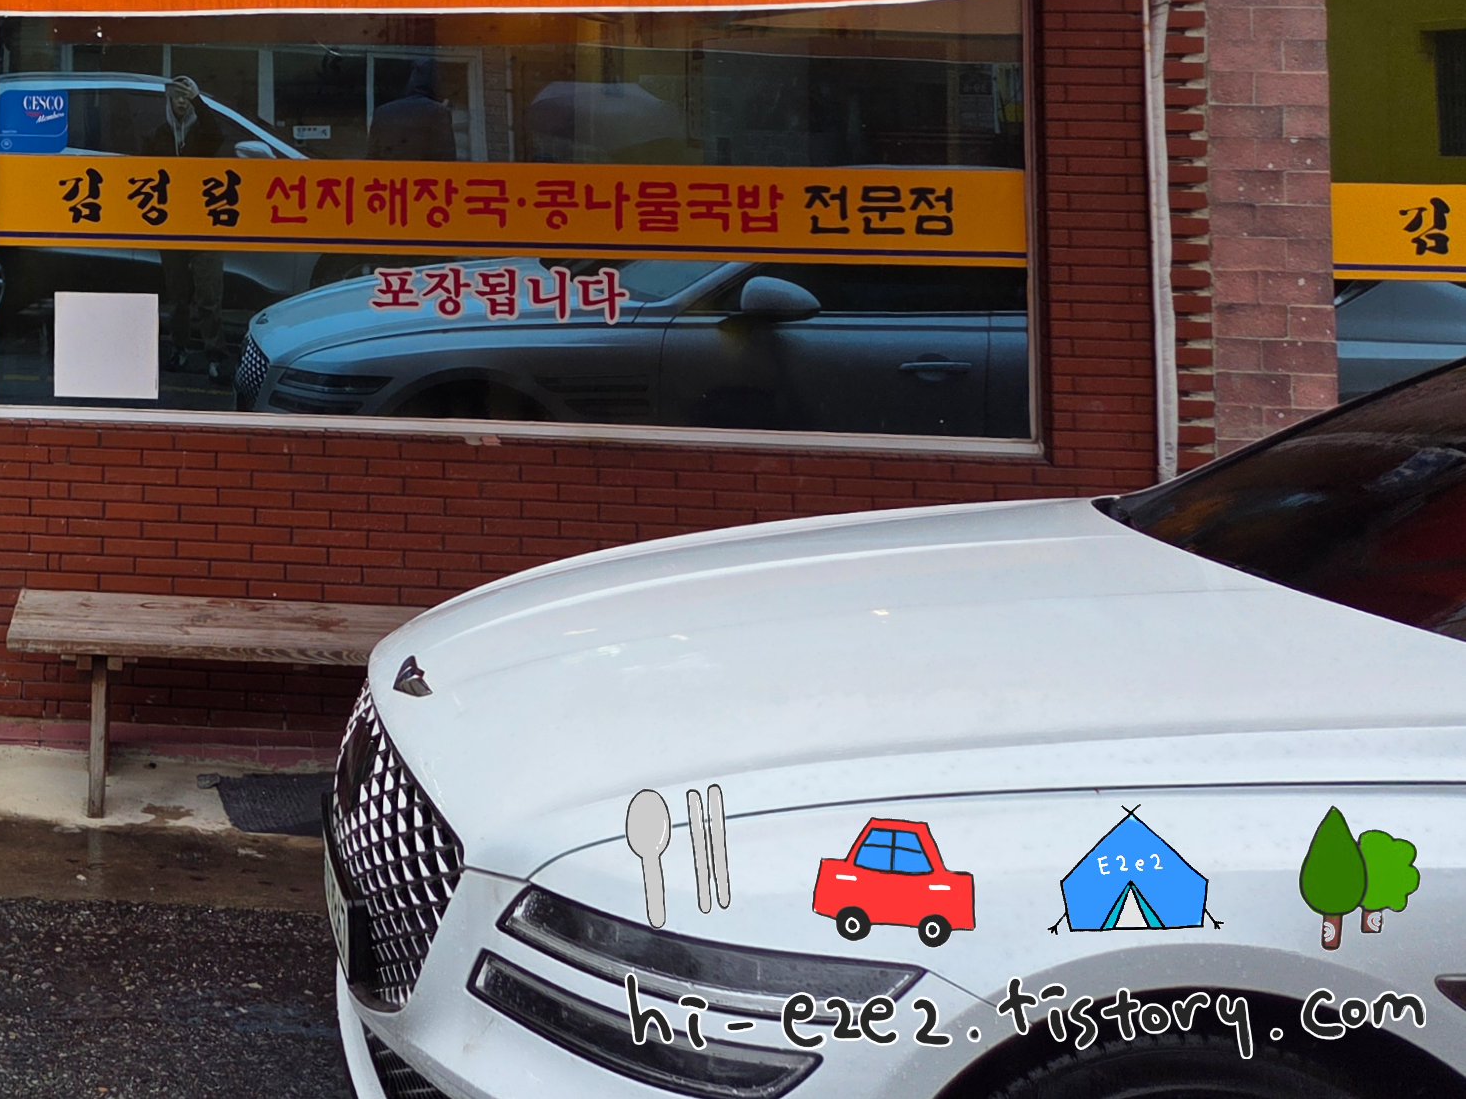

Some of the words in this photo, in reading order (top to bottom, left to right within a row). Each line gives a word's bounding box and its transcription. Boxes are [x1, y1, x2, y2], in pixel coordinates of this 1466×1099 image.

[23, 95, 64, 111] CESCO
[804, 185, 955, 236] 전문점
[1399, 197, 1450, 256] 김
[371, 267, 627, 322] 포장됩니다
